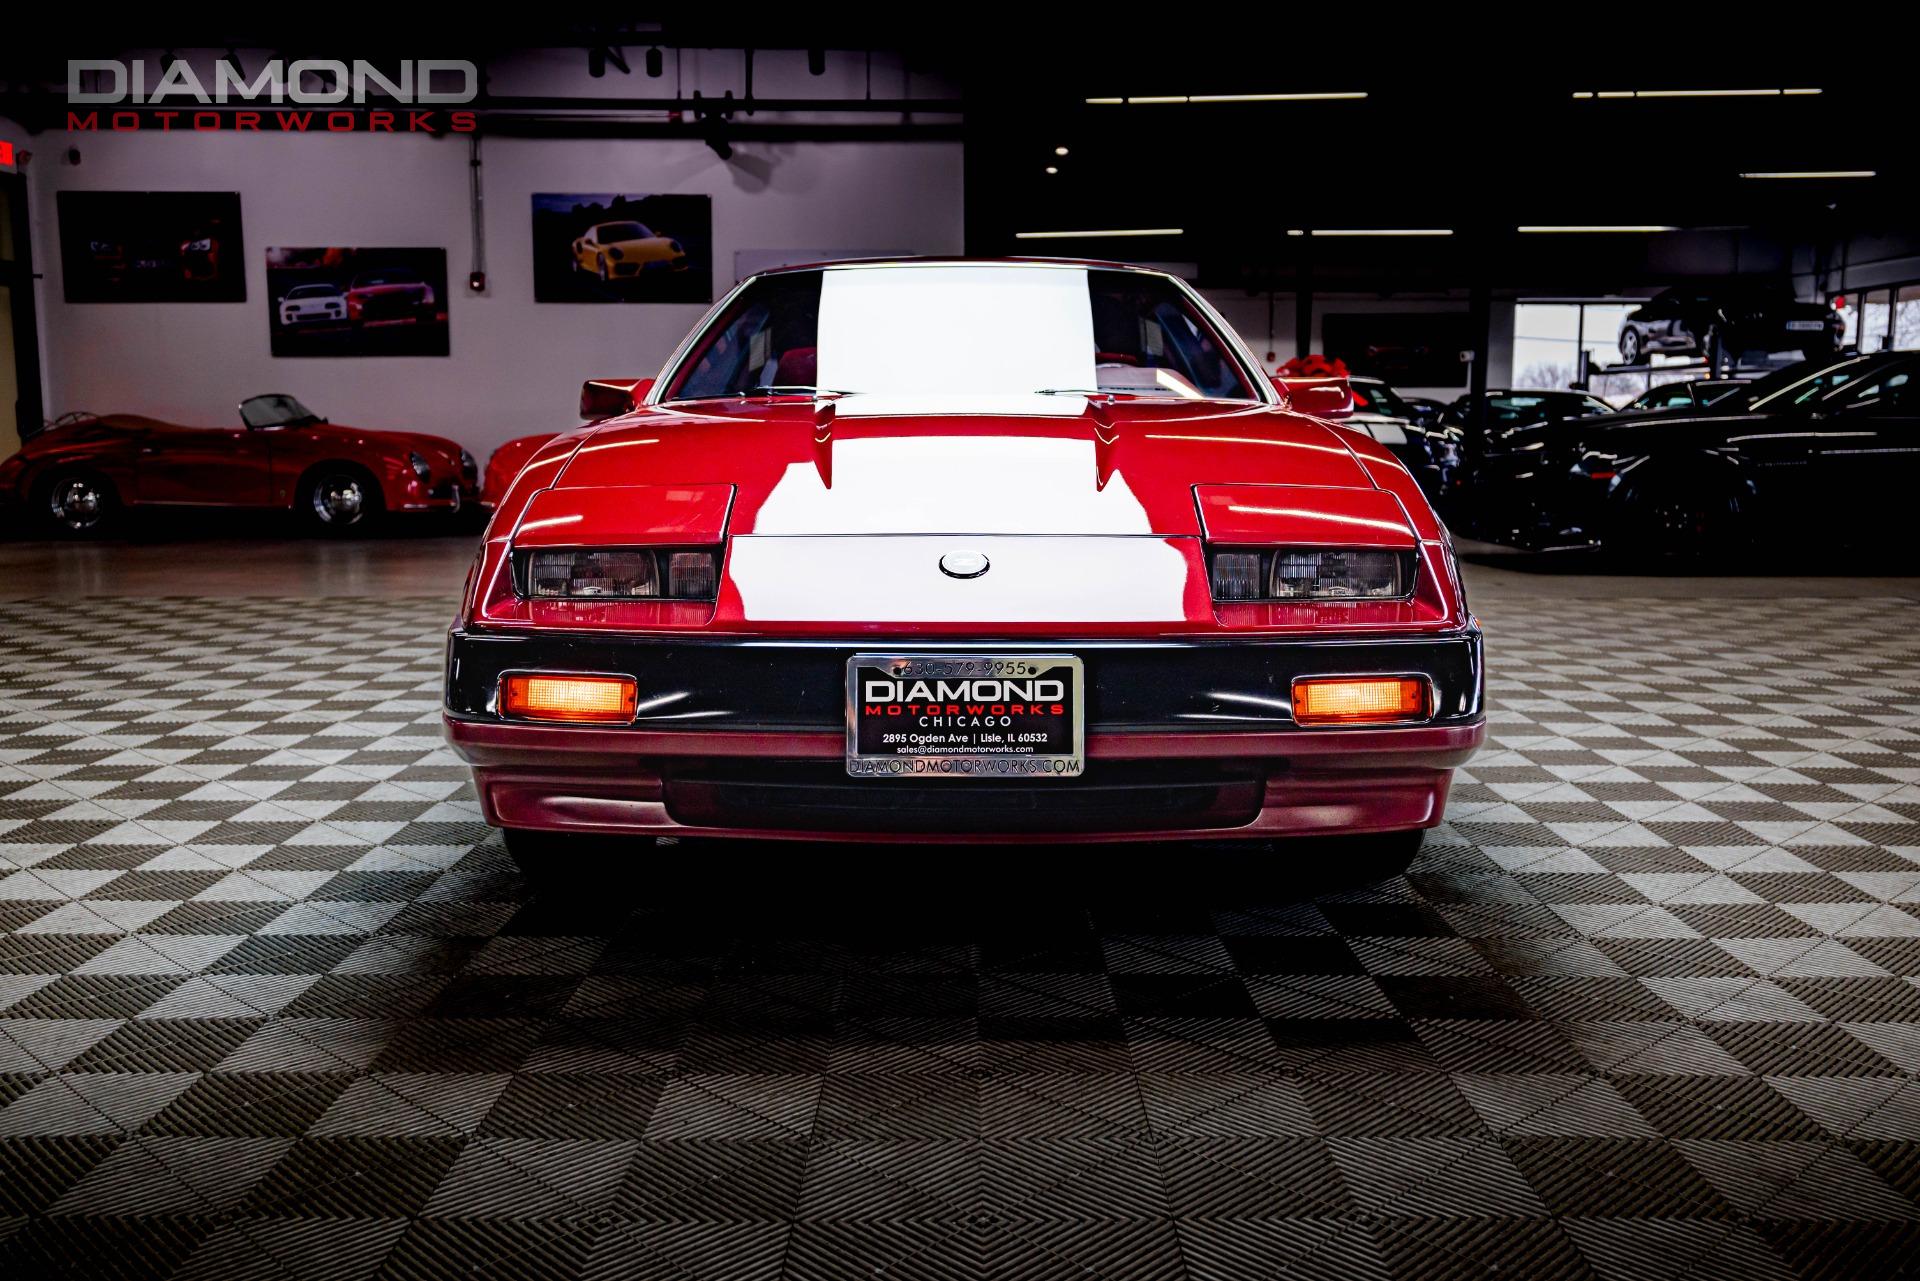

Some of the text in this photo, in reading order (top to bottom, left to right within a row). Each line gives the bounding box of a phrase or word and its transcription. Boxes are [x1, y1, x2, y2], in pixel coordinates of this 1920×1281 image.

[904, 661, 1026, 675] 630-579-9955
[866, 680, 1064, 702] DIAMOND
[865, 704, 1064, 715] MOTORWORKS
[919, 716, 1012, 727] CHICAGO
[882, 733, 907, 744] 2895
[909, 733, 946, 746] Ogden
[948, 733, 969, 744] Ave
[980, 733, 1005, 745] Lisle,
[1007, 733, 1016, 743] IL
[1017, 732, 1048, 743] 60532
[896, 744, 1034, 755] sales@diamondmotorworks.com
[850, 758, 1080, 774] DIAMONDMOTORWORKS.COM
